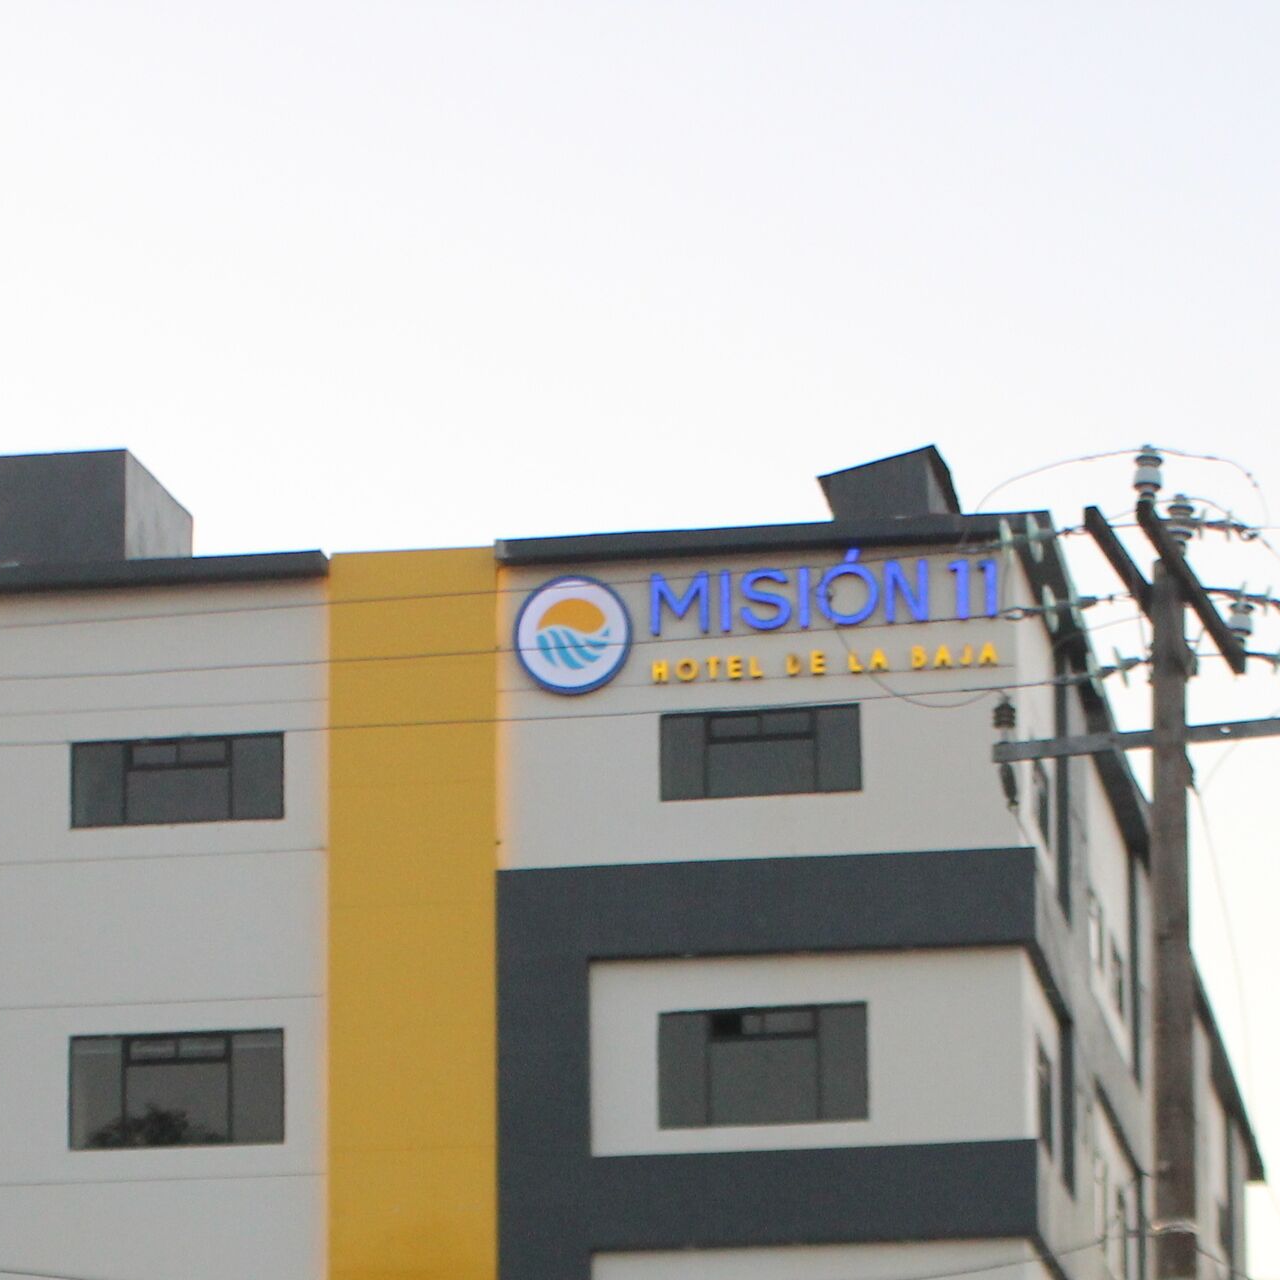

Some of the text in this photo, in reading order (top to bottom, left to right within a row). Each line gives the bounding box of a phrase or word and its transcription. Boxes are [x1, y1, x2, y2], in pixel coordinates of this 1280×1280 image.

[649, 547, 998, 637] MISIÓN 11
[651, 641, 999, 685] HOTEL DE LA BAJA
